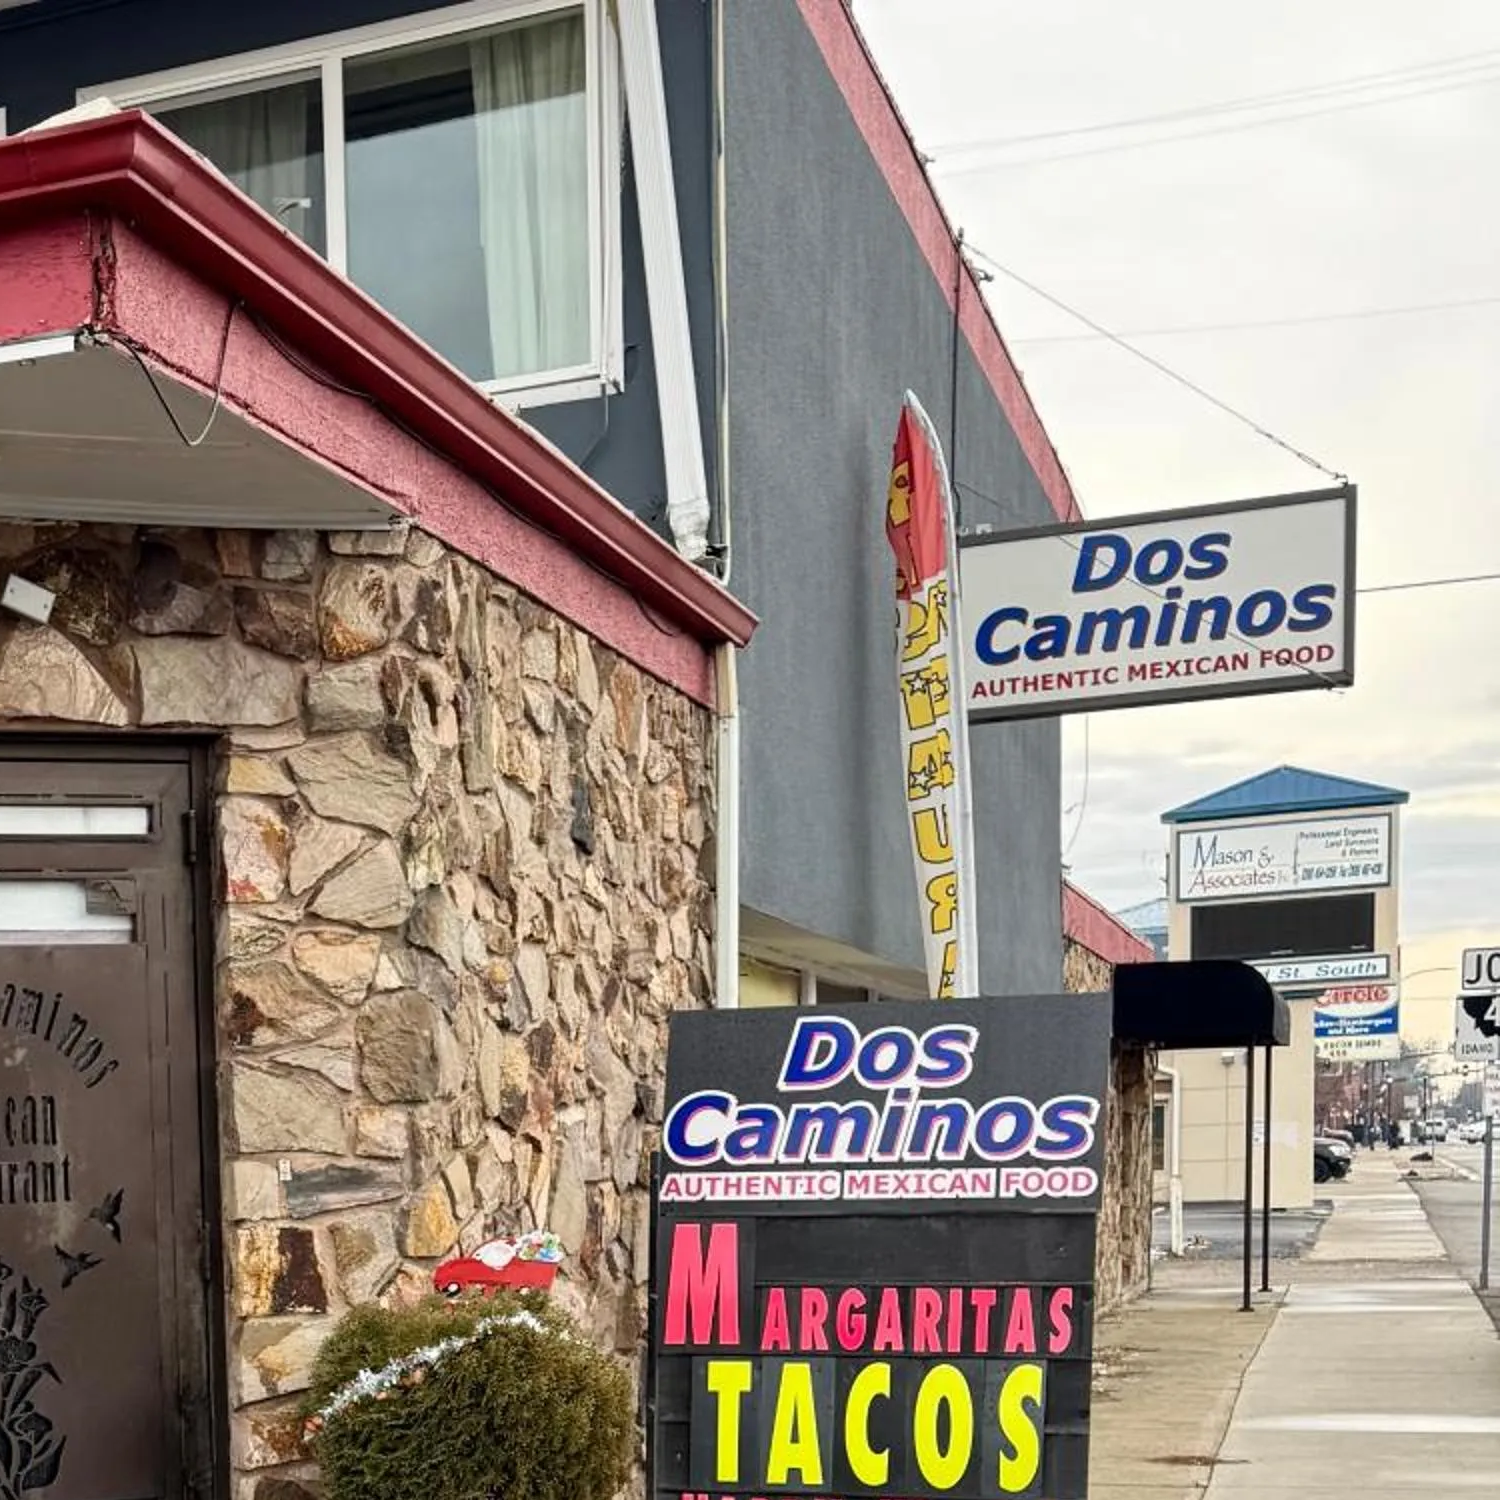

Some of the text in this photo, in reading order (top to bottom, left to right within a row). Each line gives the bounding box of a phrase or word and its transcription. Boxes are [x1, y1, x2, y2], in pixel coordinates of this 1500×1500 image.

[1071, 531, 1231, 593] Dos
[974, 584, 1336, 667] Caminos
[972, 644, 1335, 699] AUTHENTIC MEXICAN FOOD
[1193, 834, 1253, 868] Mason
[1188, 869, 1276, 895] Associates
[1315, 962, 1377, 977] South
[777, 1016, 979, 1092] Dos
[1462, 1043, 1493, 1054] IDAHO
[662, 1087, 1098, 1165] Caminos
[660, 1167, 1097, 1202] AUTHENTIC MEXICAN FOOD
[664, 1223, 1074, 1354] MARGARITAS
[707, 1360, 1044, 1493] TACOS
